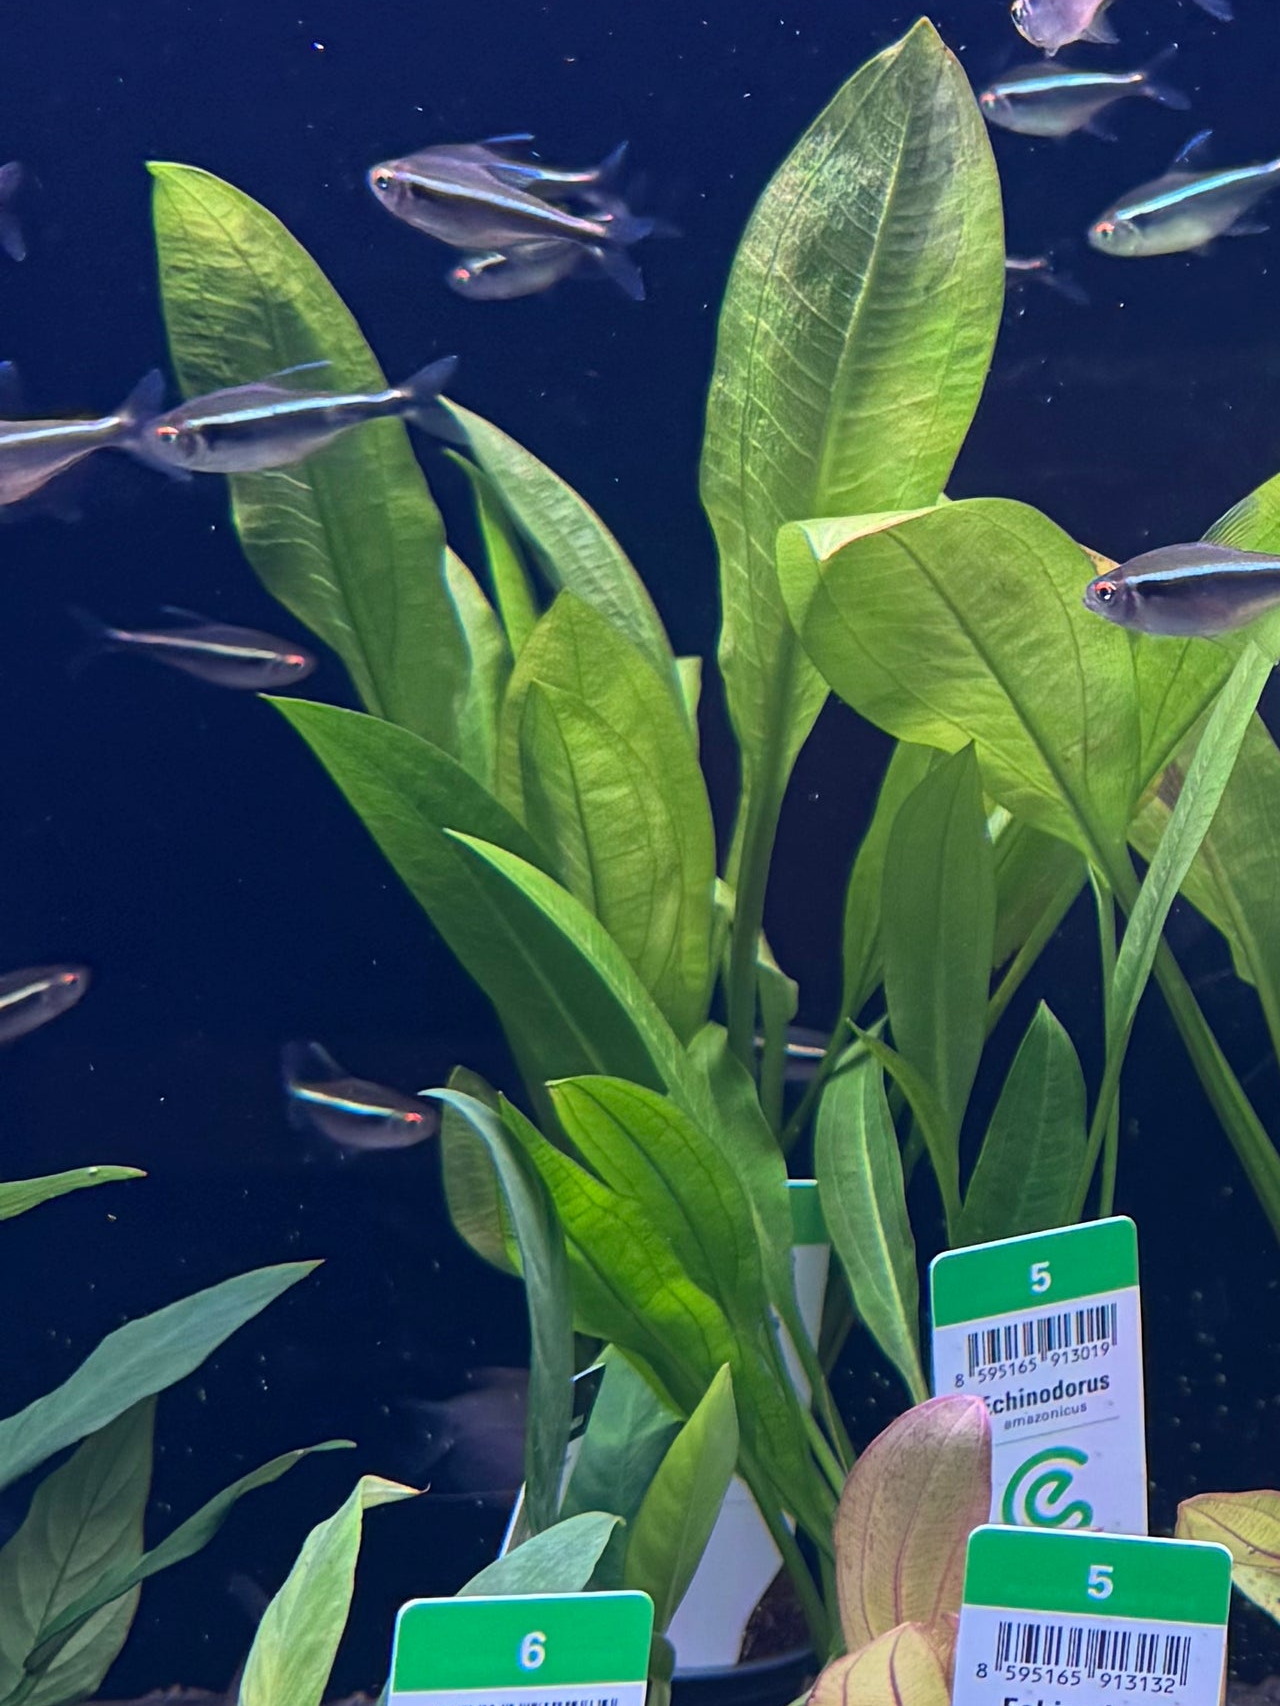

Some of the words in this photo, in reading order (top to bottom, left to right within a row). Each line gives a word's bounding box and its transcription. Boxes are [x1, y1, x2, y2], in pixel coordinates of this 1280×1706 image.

[1030, 1261, 1051, 1293] 5
[955, 1373, 965, 1388] 8
[978, 1357, 1037, 1383] 595165
[1050, 1342, 1111, 1367] 913019
[1004, 1402, 1087, 1430] amazonicus
[1087, 1565, 1114, 1600] 5
[519, 1631, 547, 1671] 6
[975, 1662, 988, 1679] 8
[1005, 1665, 1081, 1686] 595165
[1100, 1673, 1175, 1694] 913132
